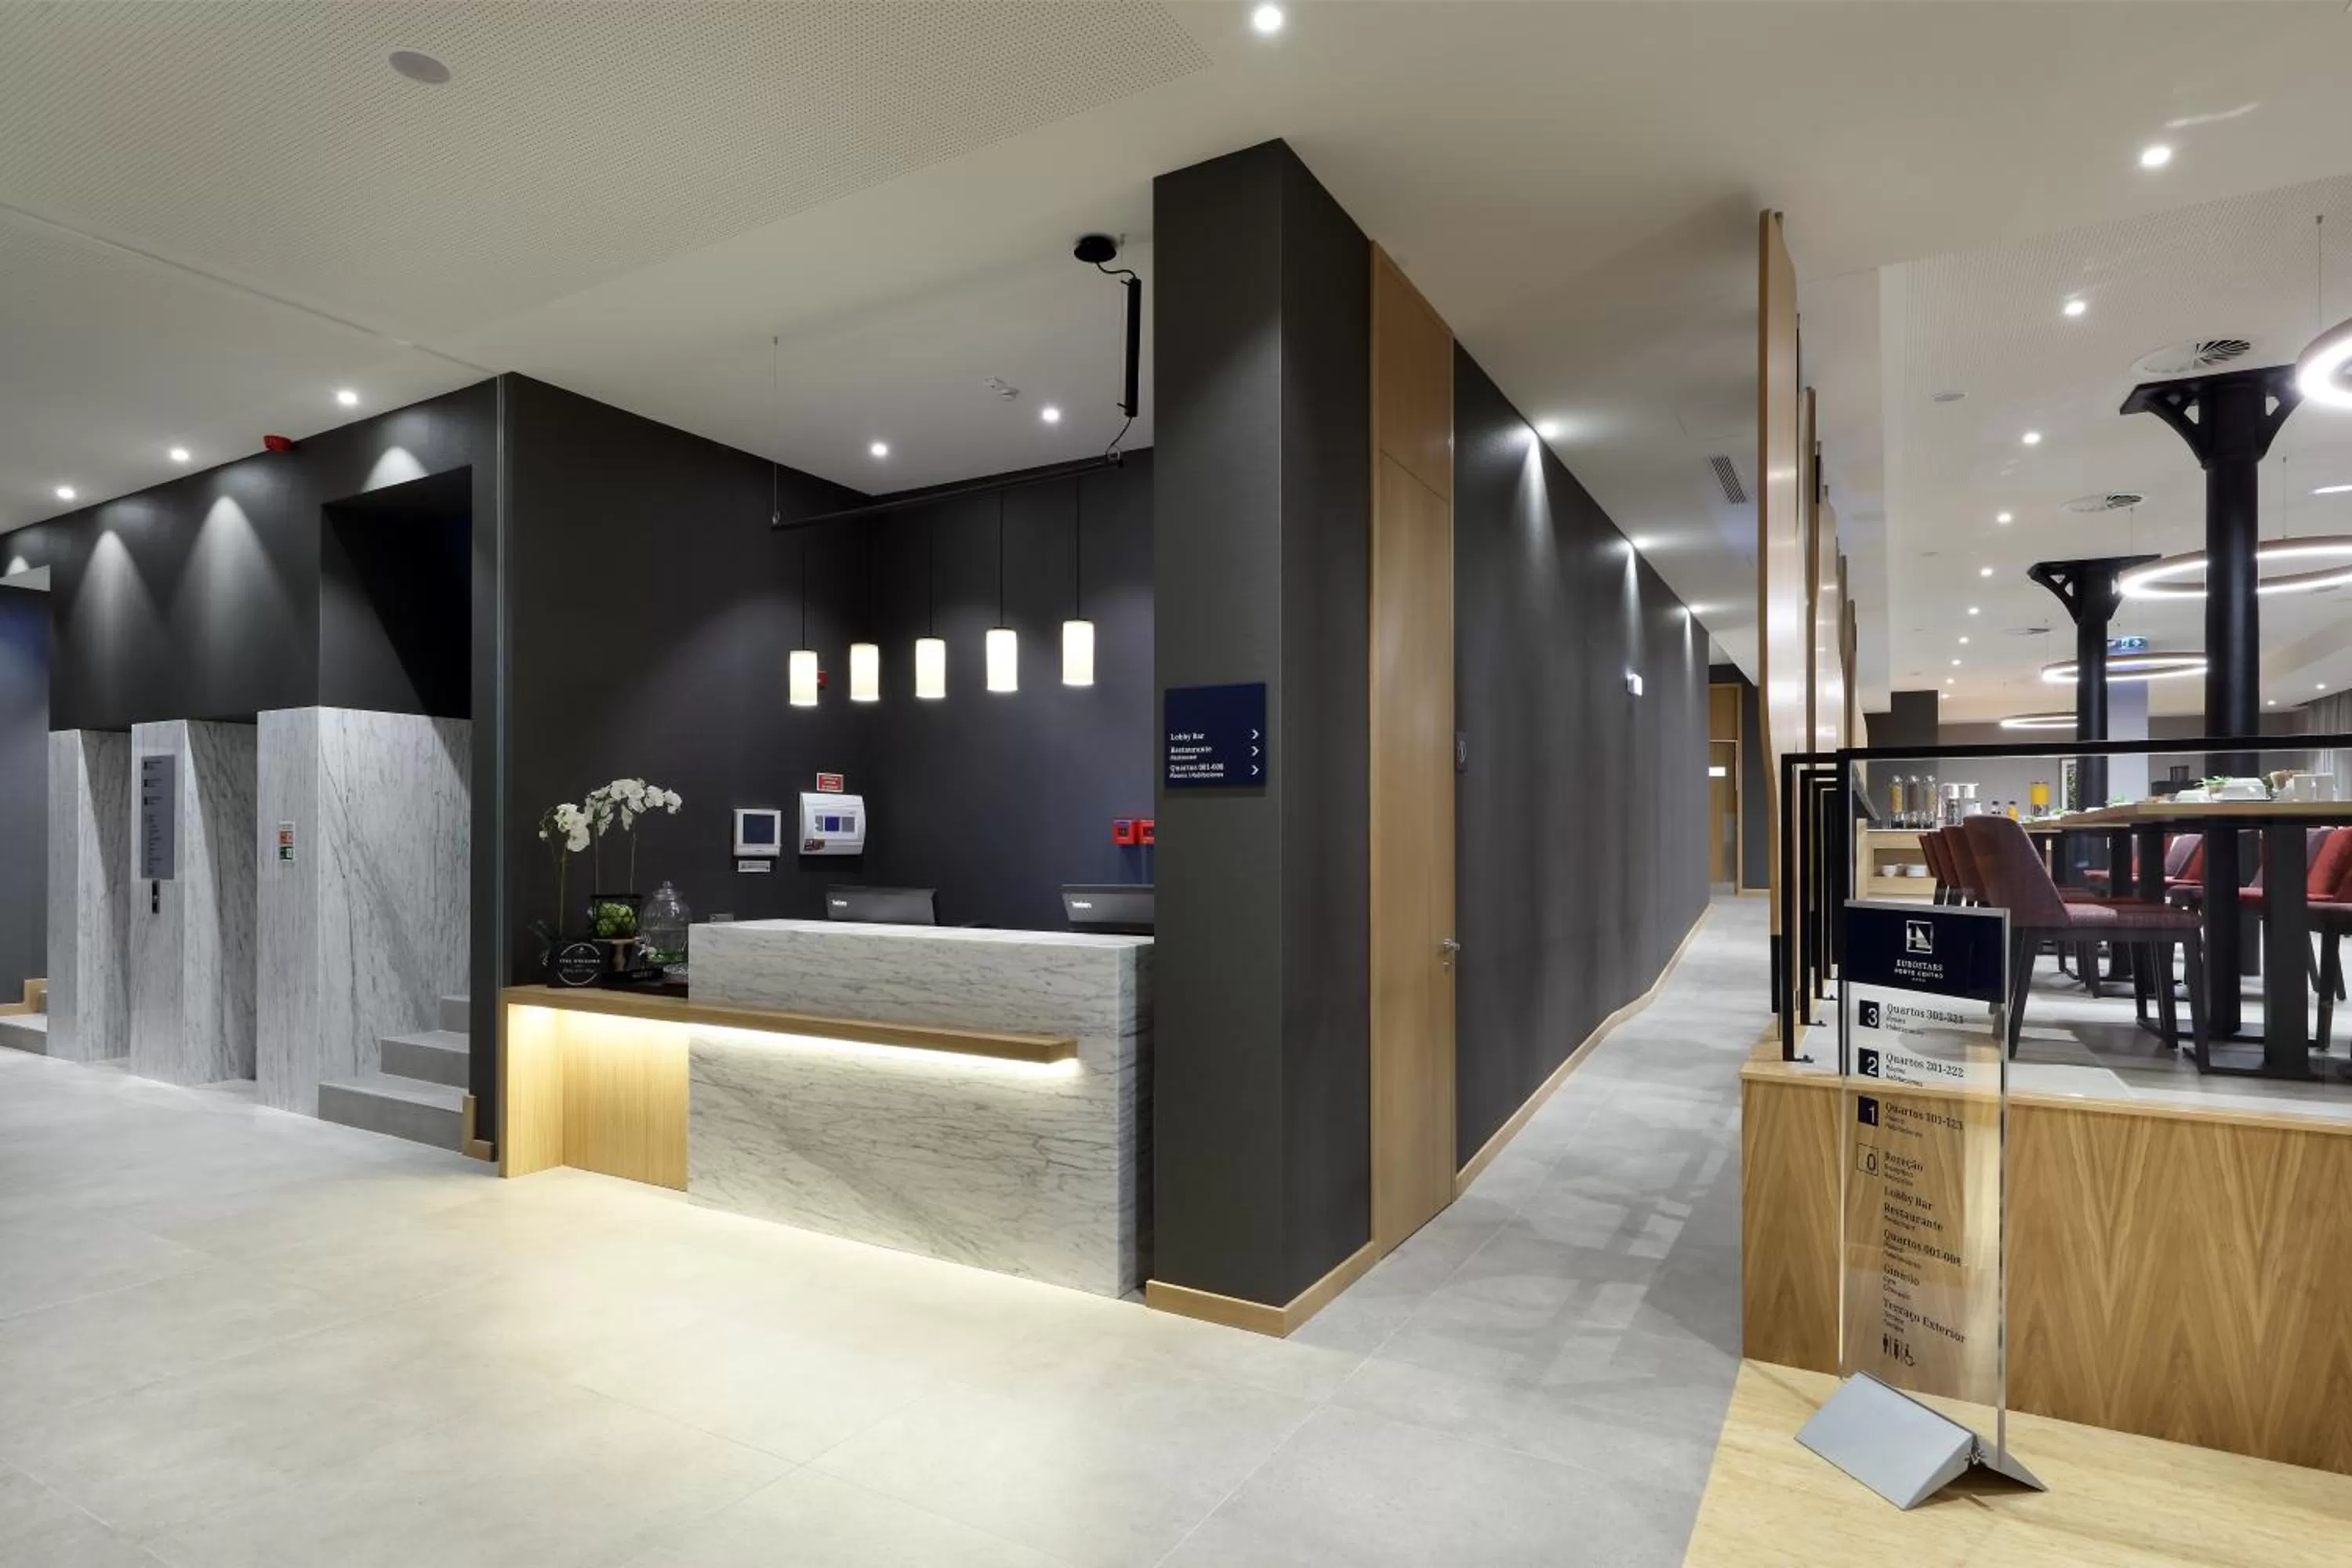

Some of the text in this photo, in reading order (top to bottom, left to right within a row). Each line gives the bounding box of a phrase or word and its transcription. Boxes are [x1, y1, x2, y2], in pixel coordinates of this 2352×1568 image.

[1170, 733, 1191, 742] Lobby
[1896, 959, 1944, 971] EUROSTARS
[1917, 971, 1944, 979] CENTRO
[1867, 1007, 1878, 1025] 3
[1886, 1003, 1925, 1018] Quartos
[1867, 1056, 1878, 1075] 2
[1886, 1053, 1924, 1069] Quartos
[1868, 1106, 1875, 1123] 1
[1886, 1102, 1924, 1120] Quartos
[1867, 1153, 1876, 1171] 0
[1884, 1185, 1933, 1210] Lobby Bar
[1884, 1203, 1944, 1231] Restaurante
[1884, 1229, 1922, 1252] Quartos
[1922, 1316, 1965, 1343] Exterior
